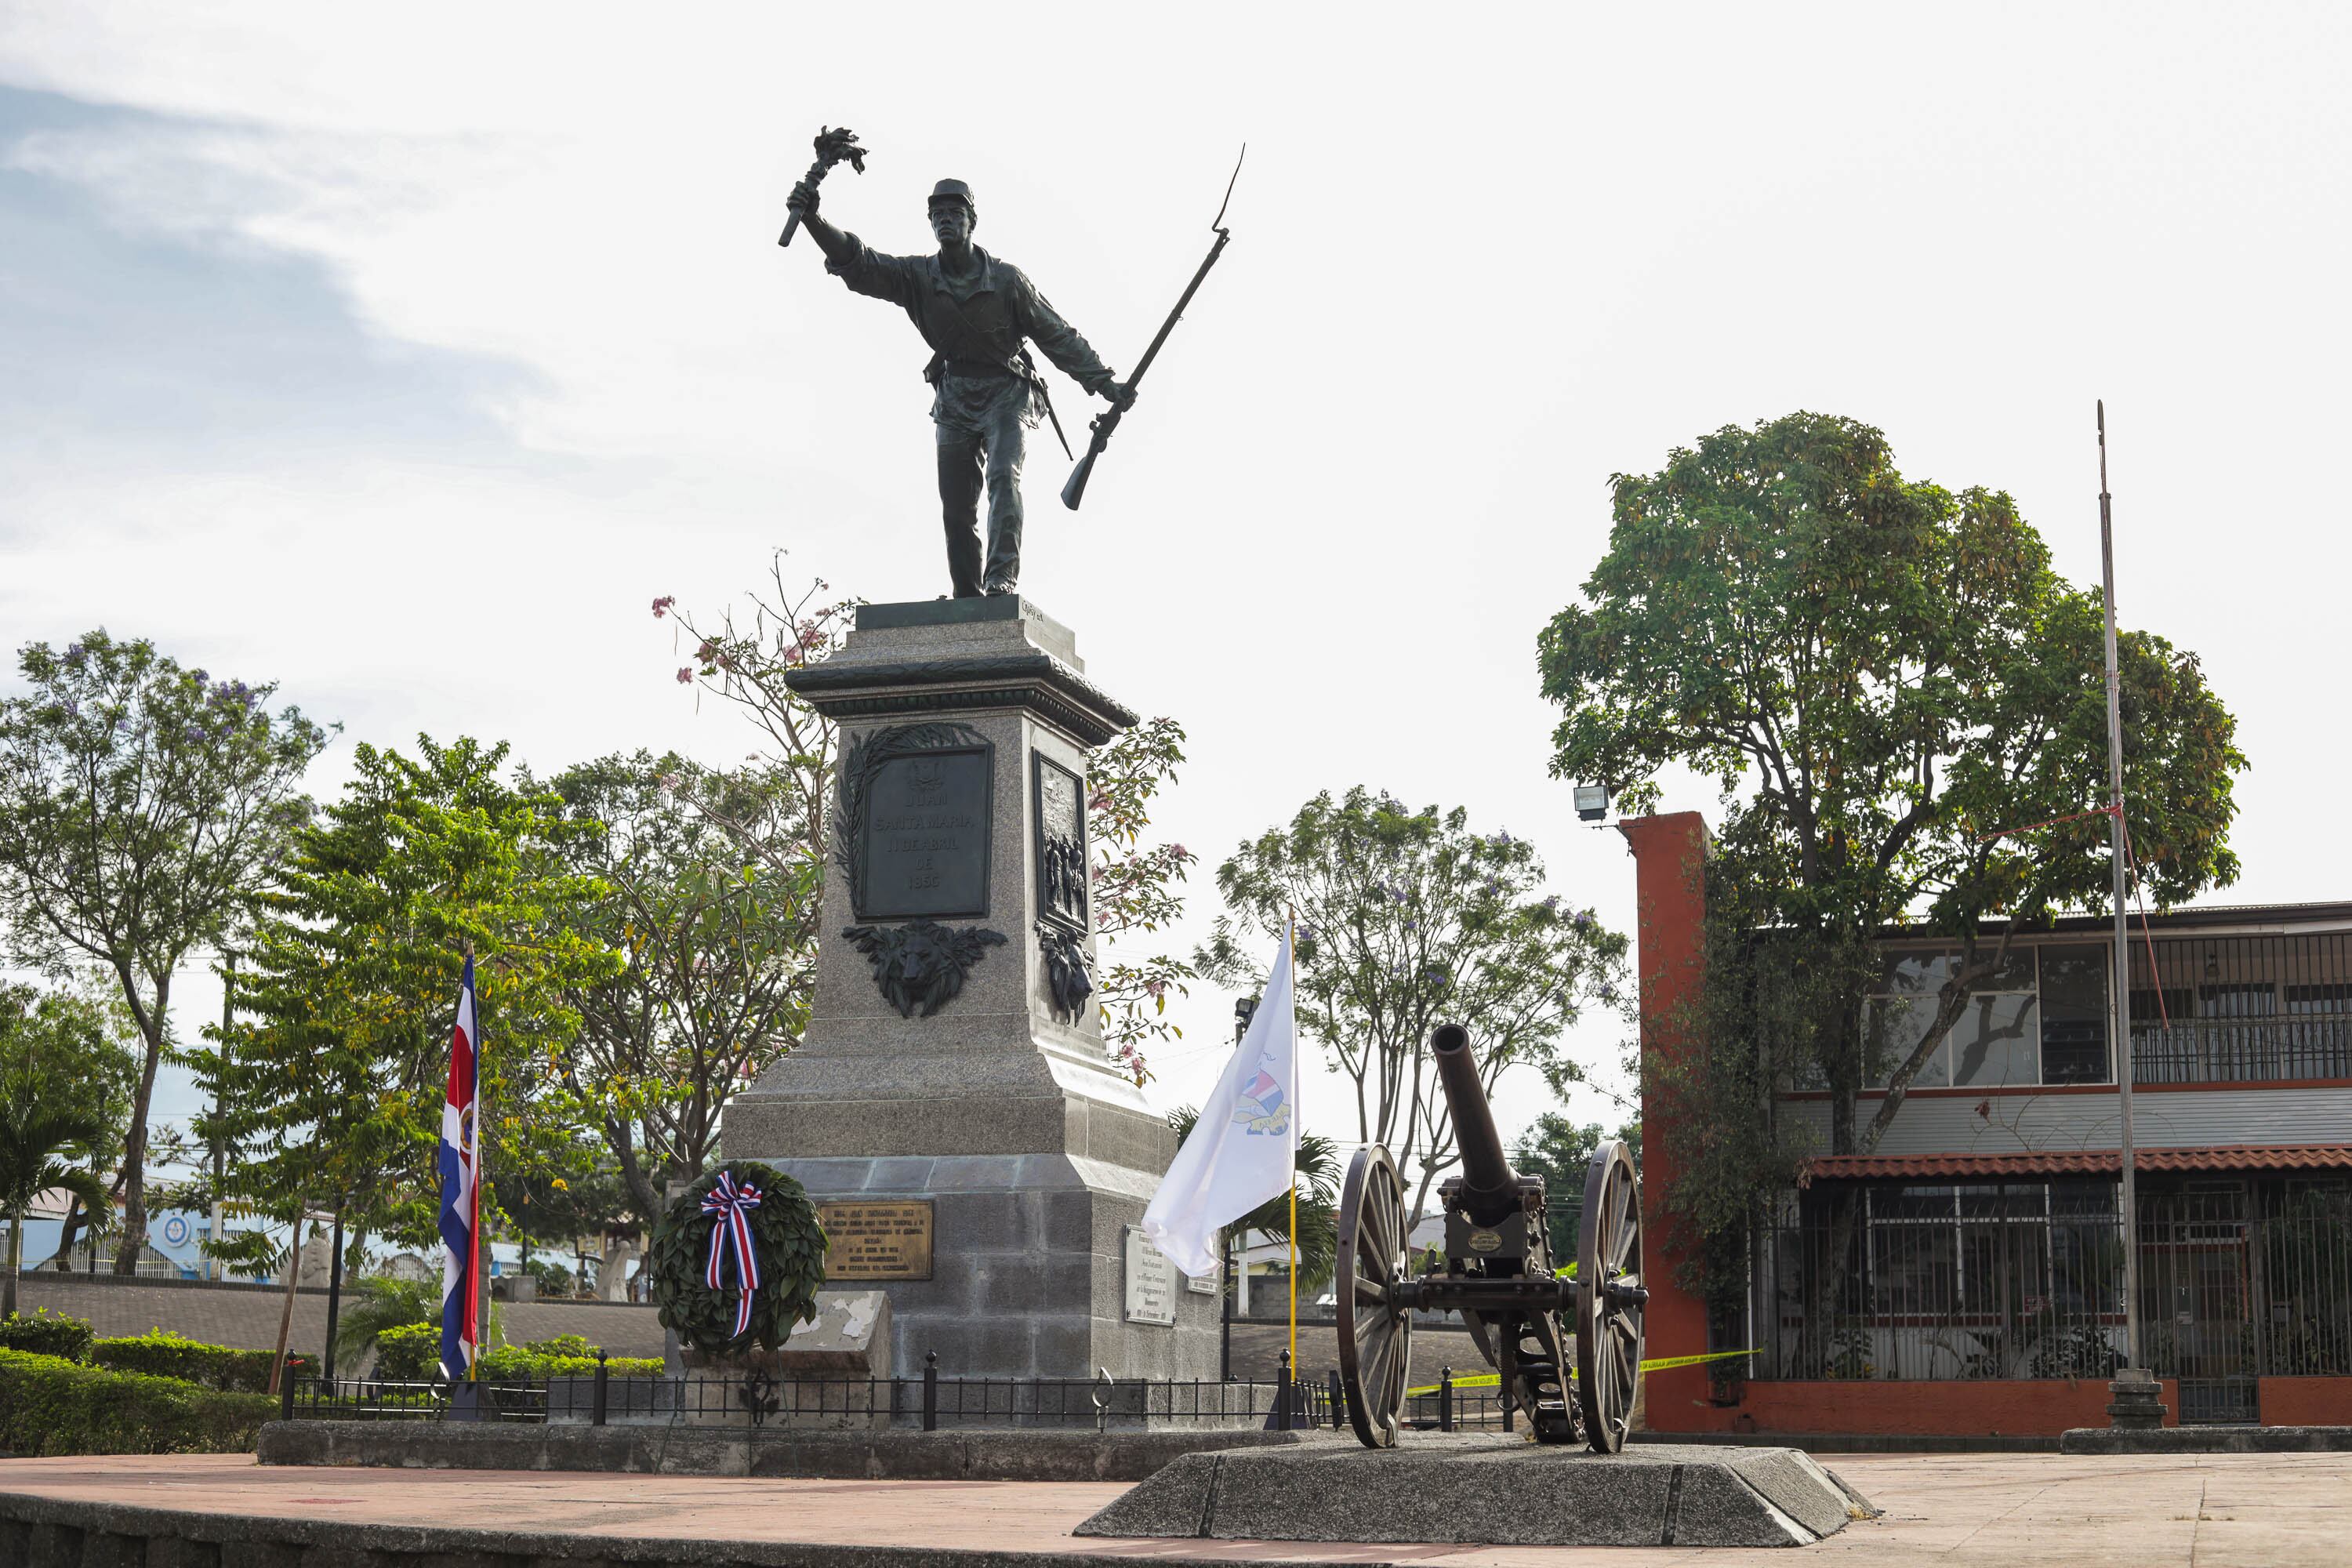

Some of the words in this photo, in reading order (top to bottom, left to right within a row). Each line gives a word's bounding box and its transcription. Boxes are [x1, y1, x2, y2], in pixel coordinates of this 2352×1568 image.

[905, 793, 948, 808] JUAN
[915, 858, 934, 871] DE
[909, 874, 941, 891] 1856
